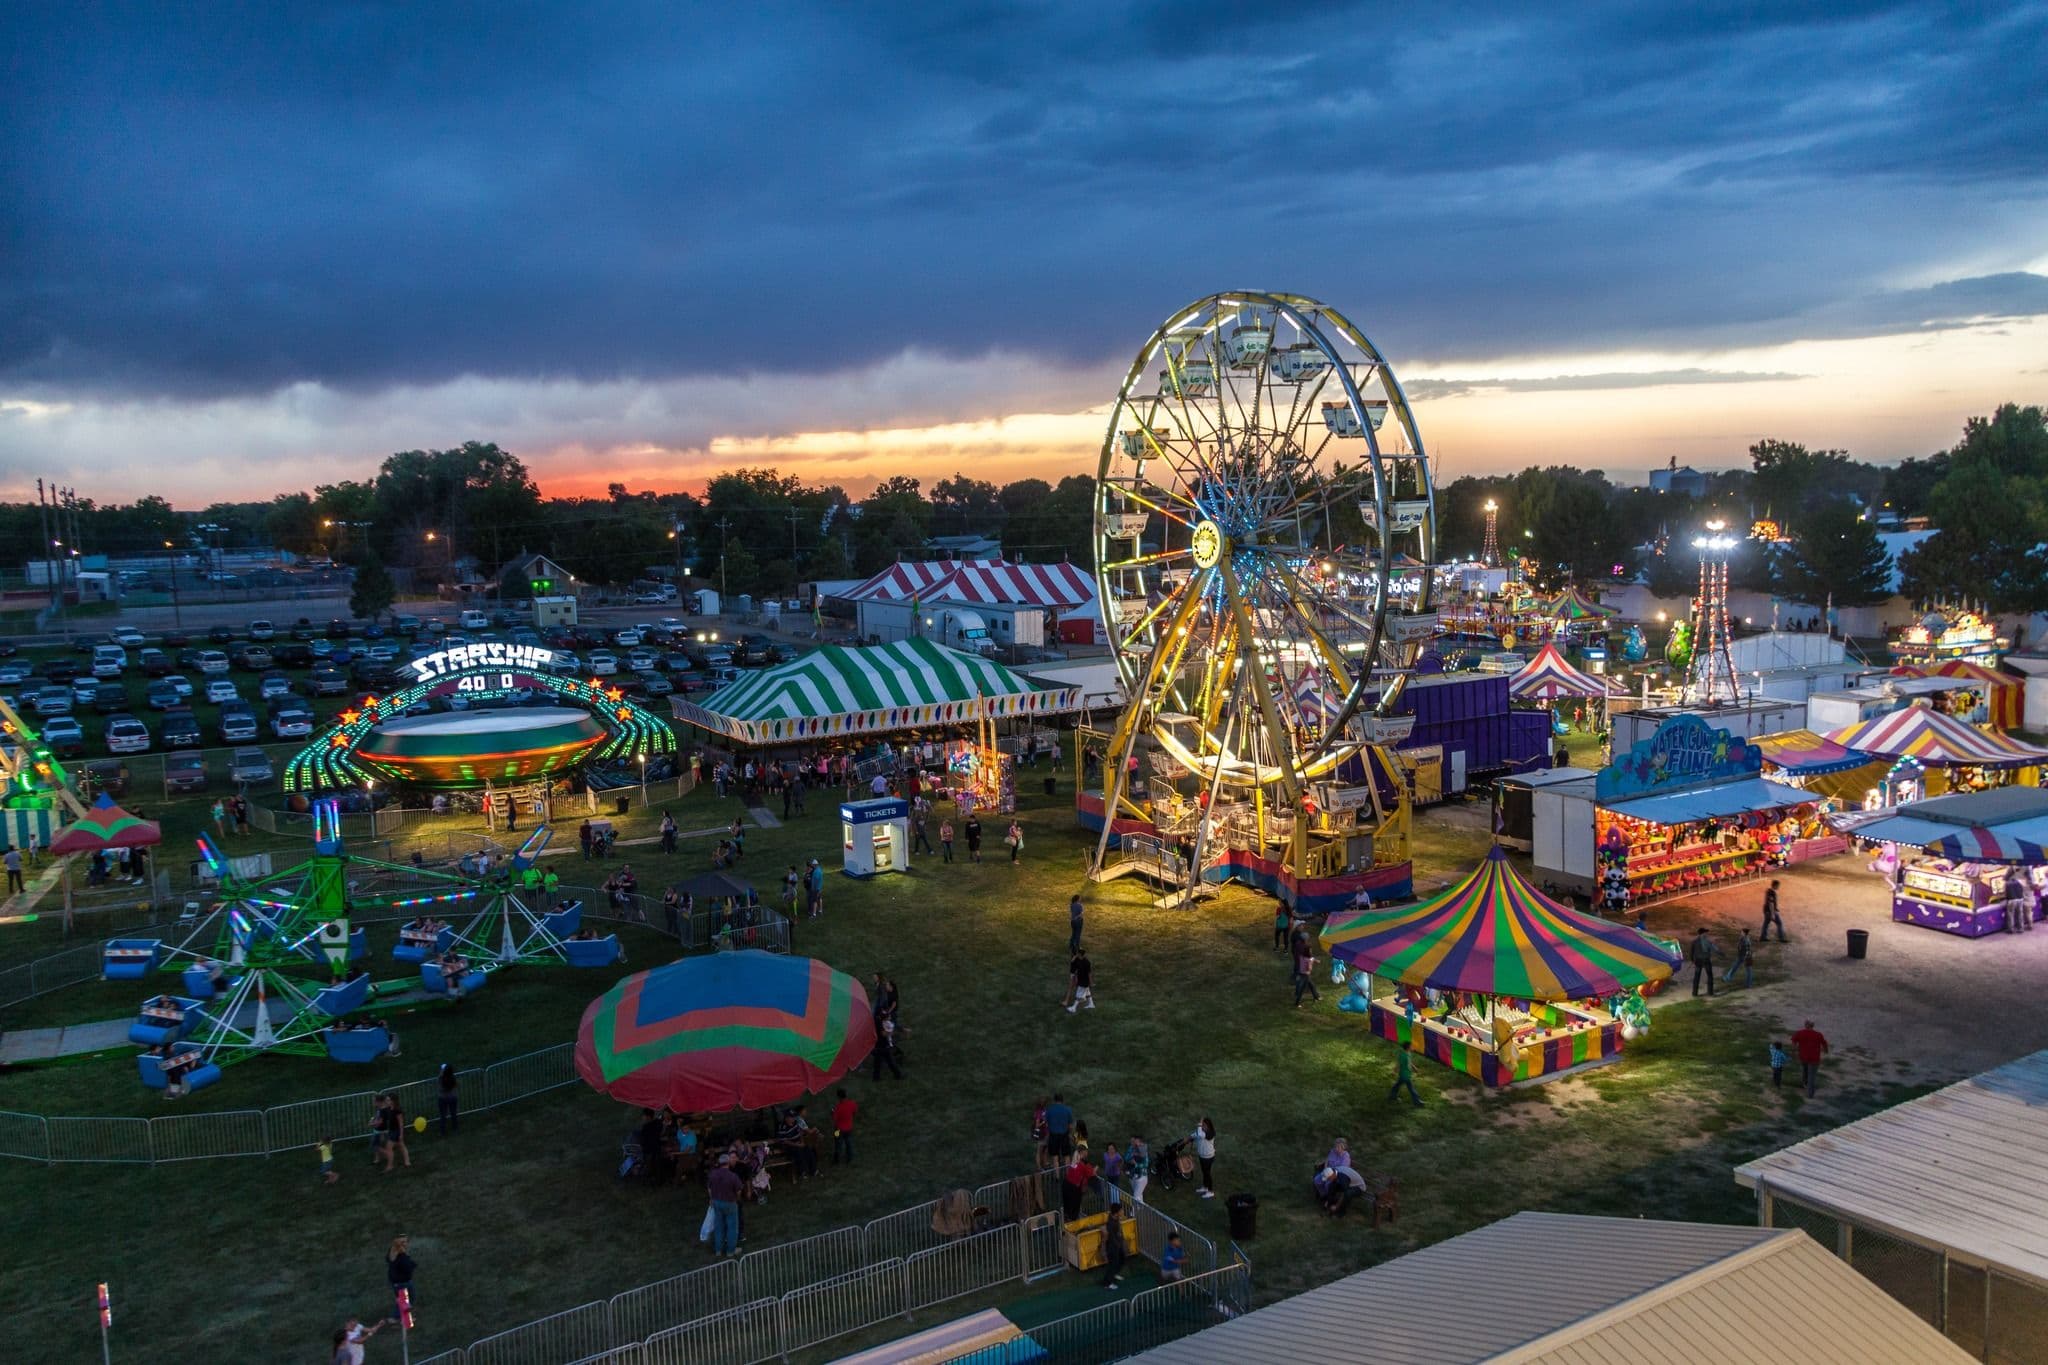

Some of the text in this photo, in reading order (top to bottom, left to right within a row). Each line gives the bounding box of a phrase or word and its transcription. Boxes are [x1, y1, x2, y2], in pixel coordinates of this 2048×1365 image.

[411, 643, 552, 683] STARSHIP
[1651, 724, 1712, 755] WATER GUN
[864, 807, 897, 819] TICKETS
